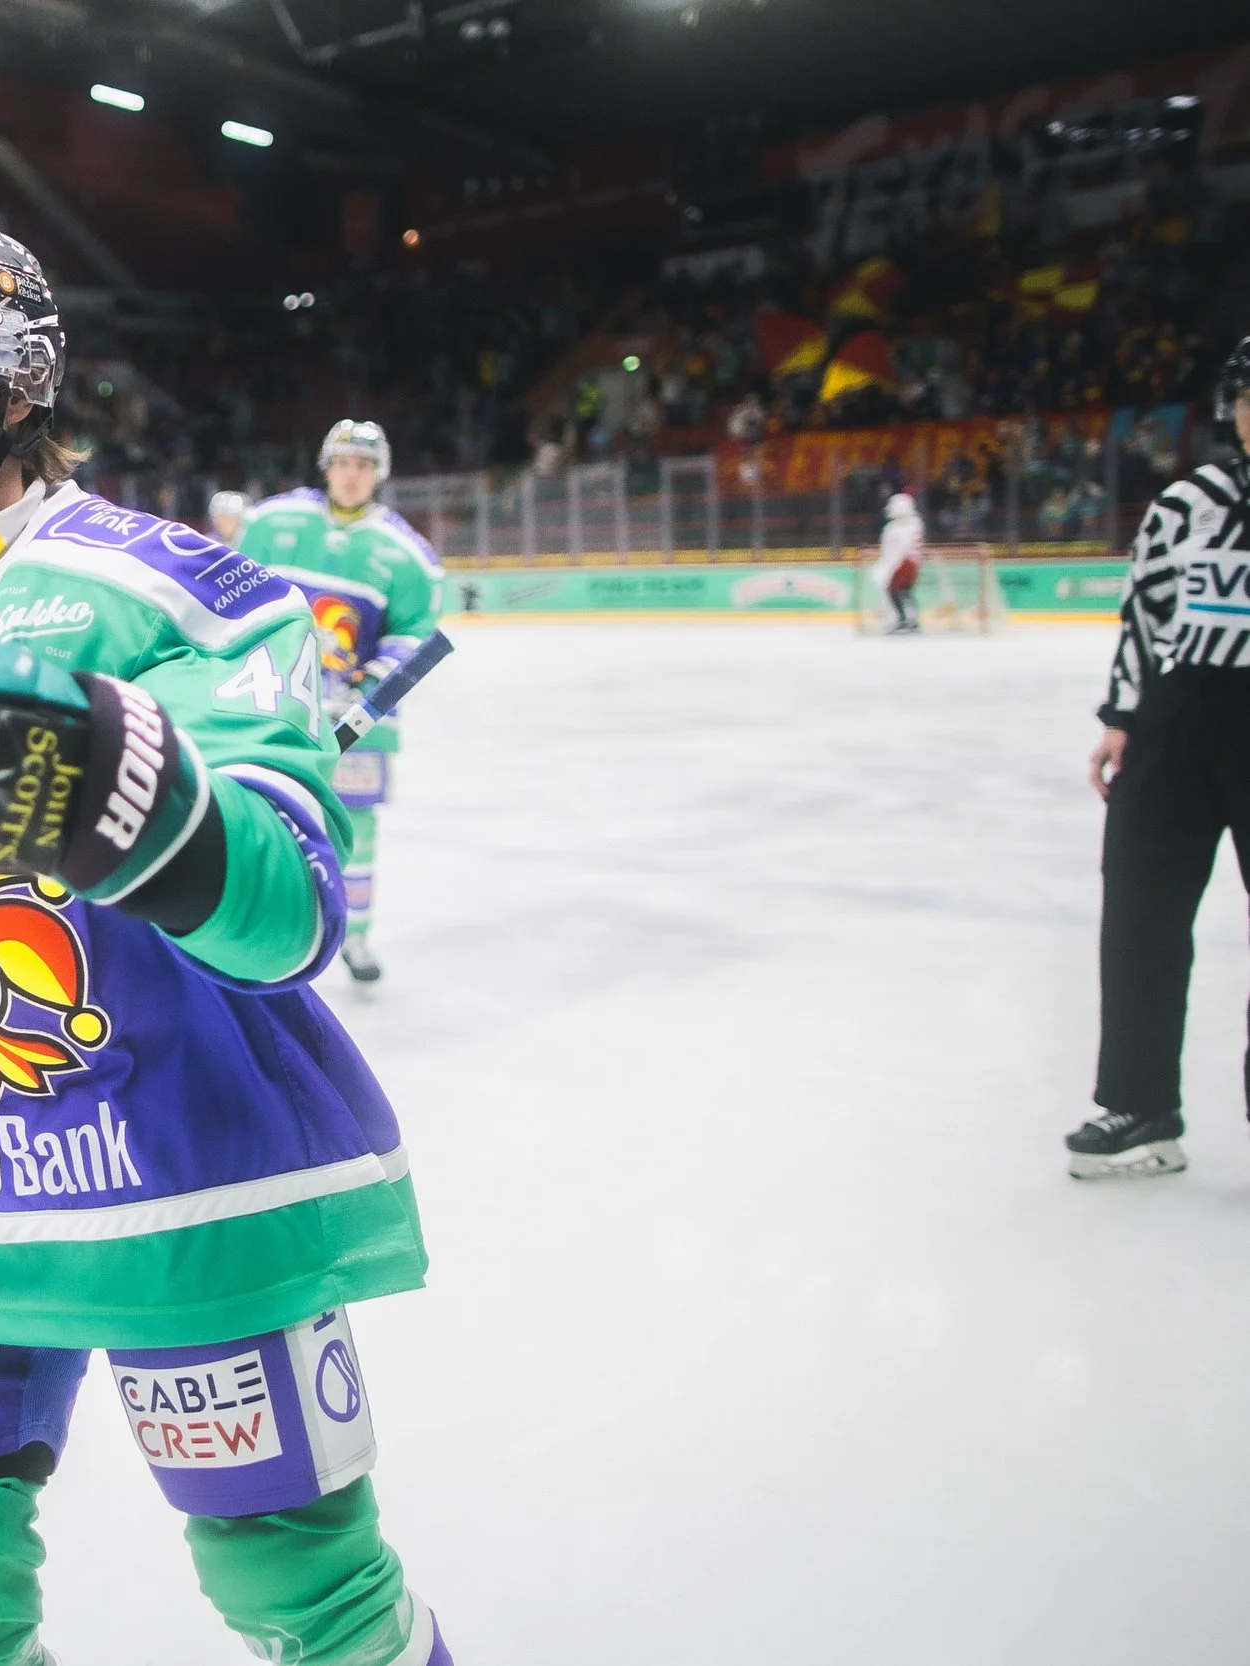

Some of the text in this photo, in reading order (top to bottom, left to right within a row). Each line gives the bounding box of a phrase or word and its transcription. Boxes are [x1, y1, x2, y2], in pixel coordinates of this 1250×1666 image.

[83, 511, 140, 537] link
[214, 557, 261, 590] TOYO
[45, 646, 72, 660] OLUT
[214, 628, 321, 740] 44
[120, 1360, 266, 1414] CABLE
[136, 1411, 262, 1459] CREW
